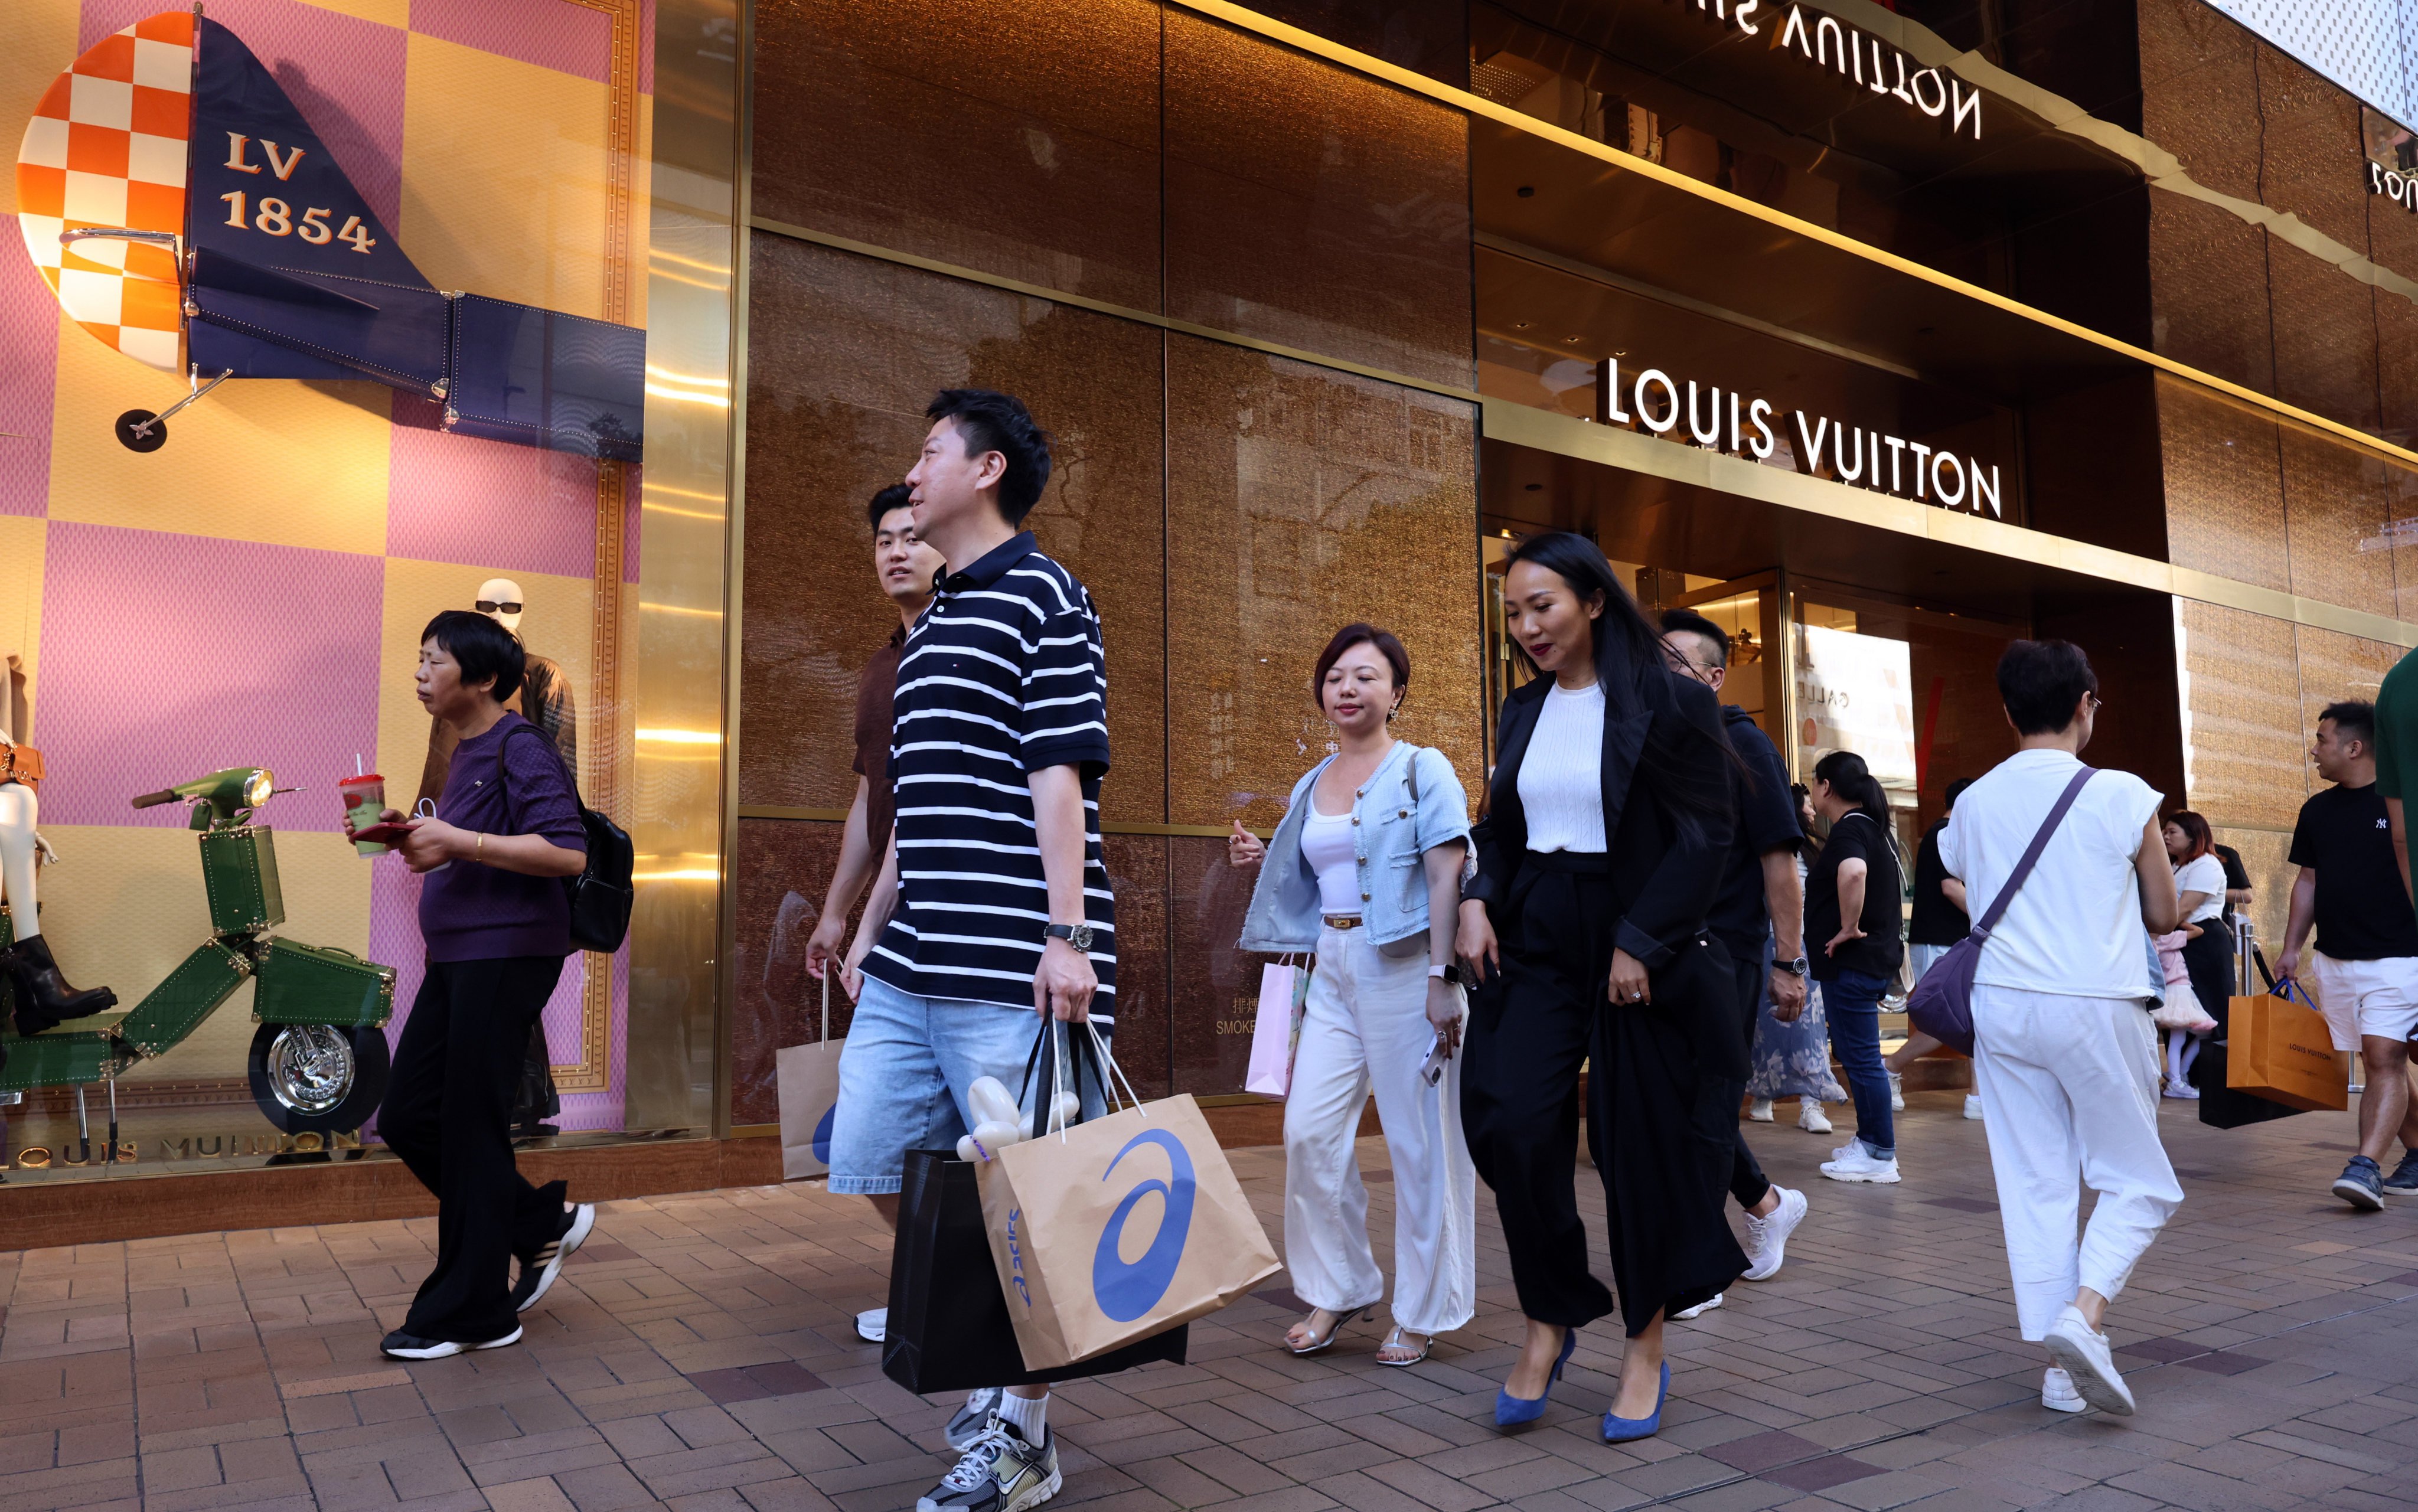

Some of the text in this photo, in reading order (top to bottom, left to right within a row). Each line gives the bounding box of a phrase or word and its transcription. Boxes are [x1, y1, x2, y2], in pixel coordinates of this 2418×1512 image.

[223, 131, 306, 181] LV
[220, 190, 376, 254] 1854
[1609, 357, 2001, 518] LOUIS VUITTON
[1216, 1020, 1256, 1034] SMOKE
[2289, 1043, 2331, 1061] LOUIS VUITTON
